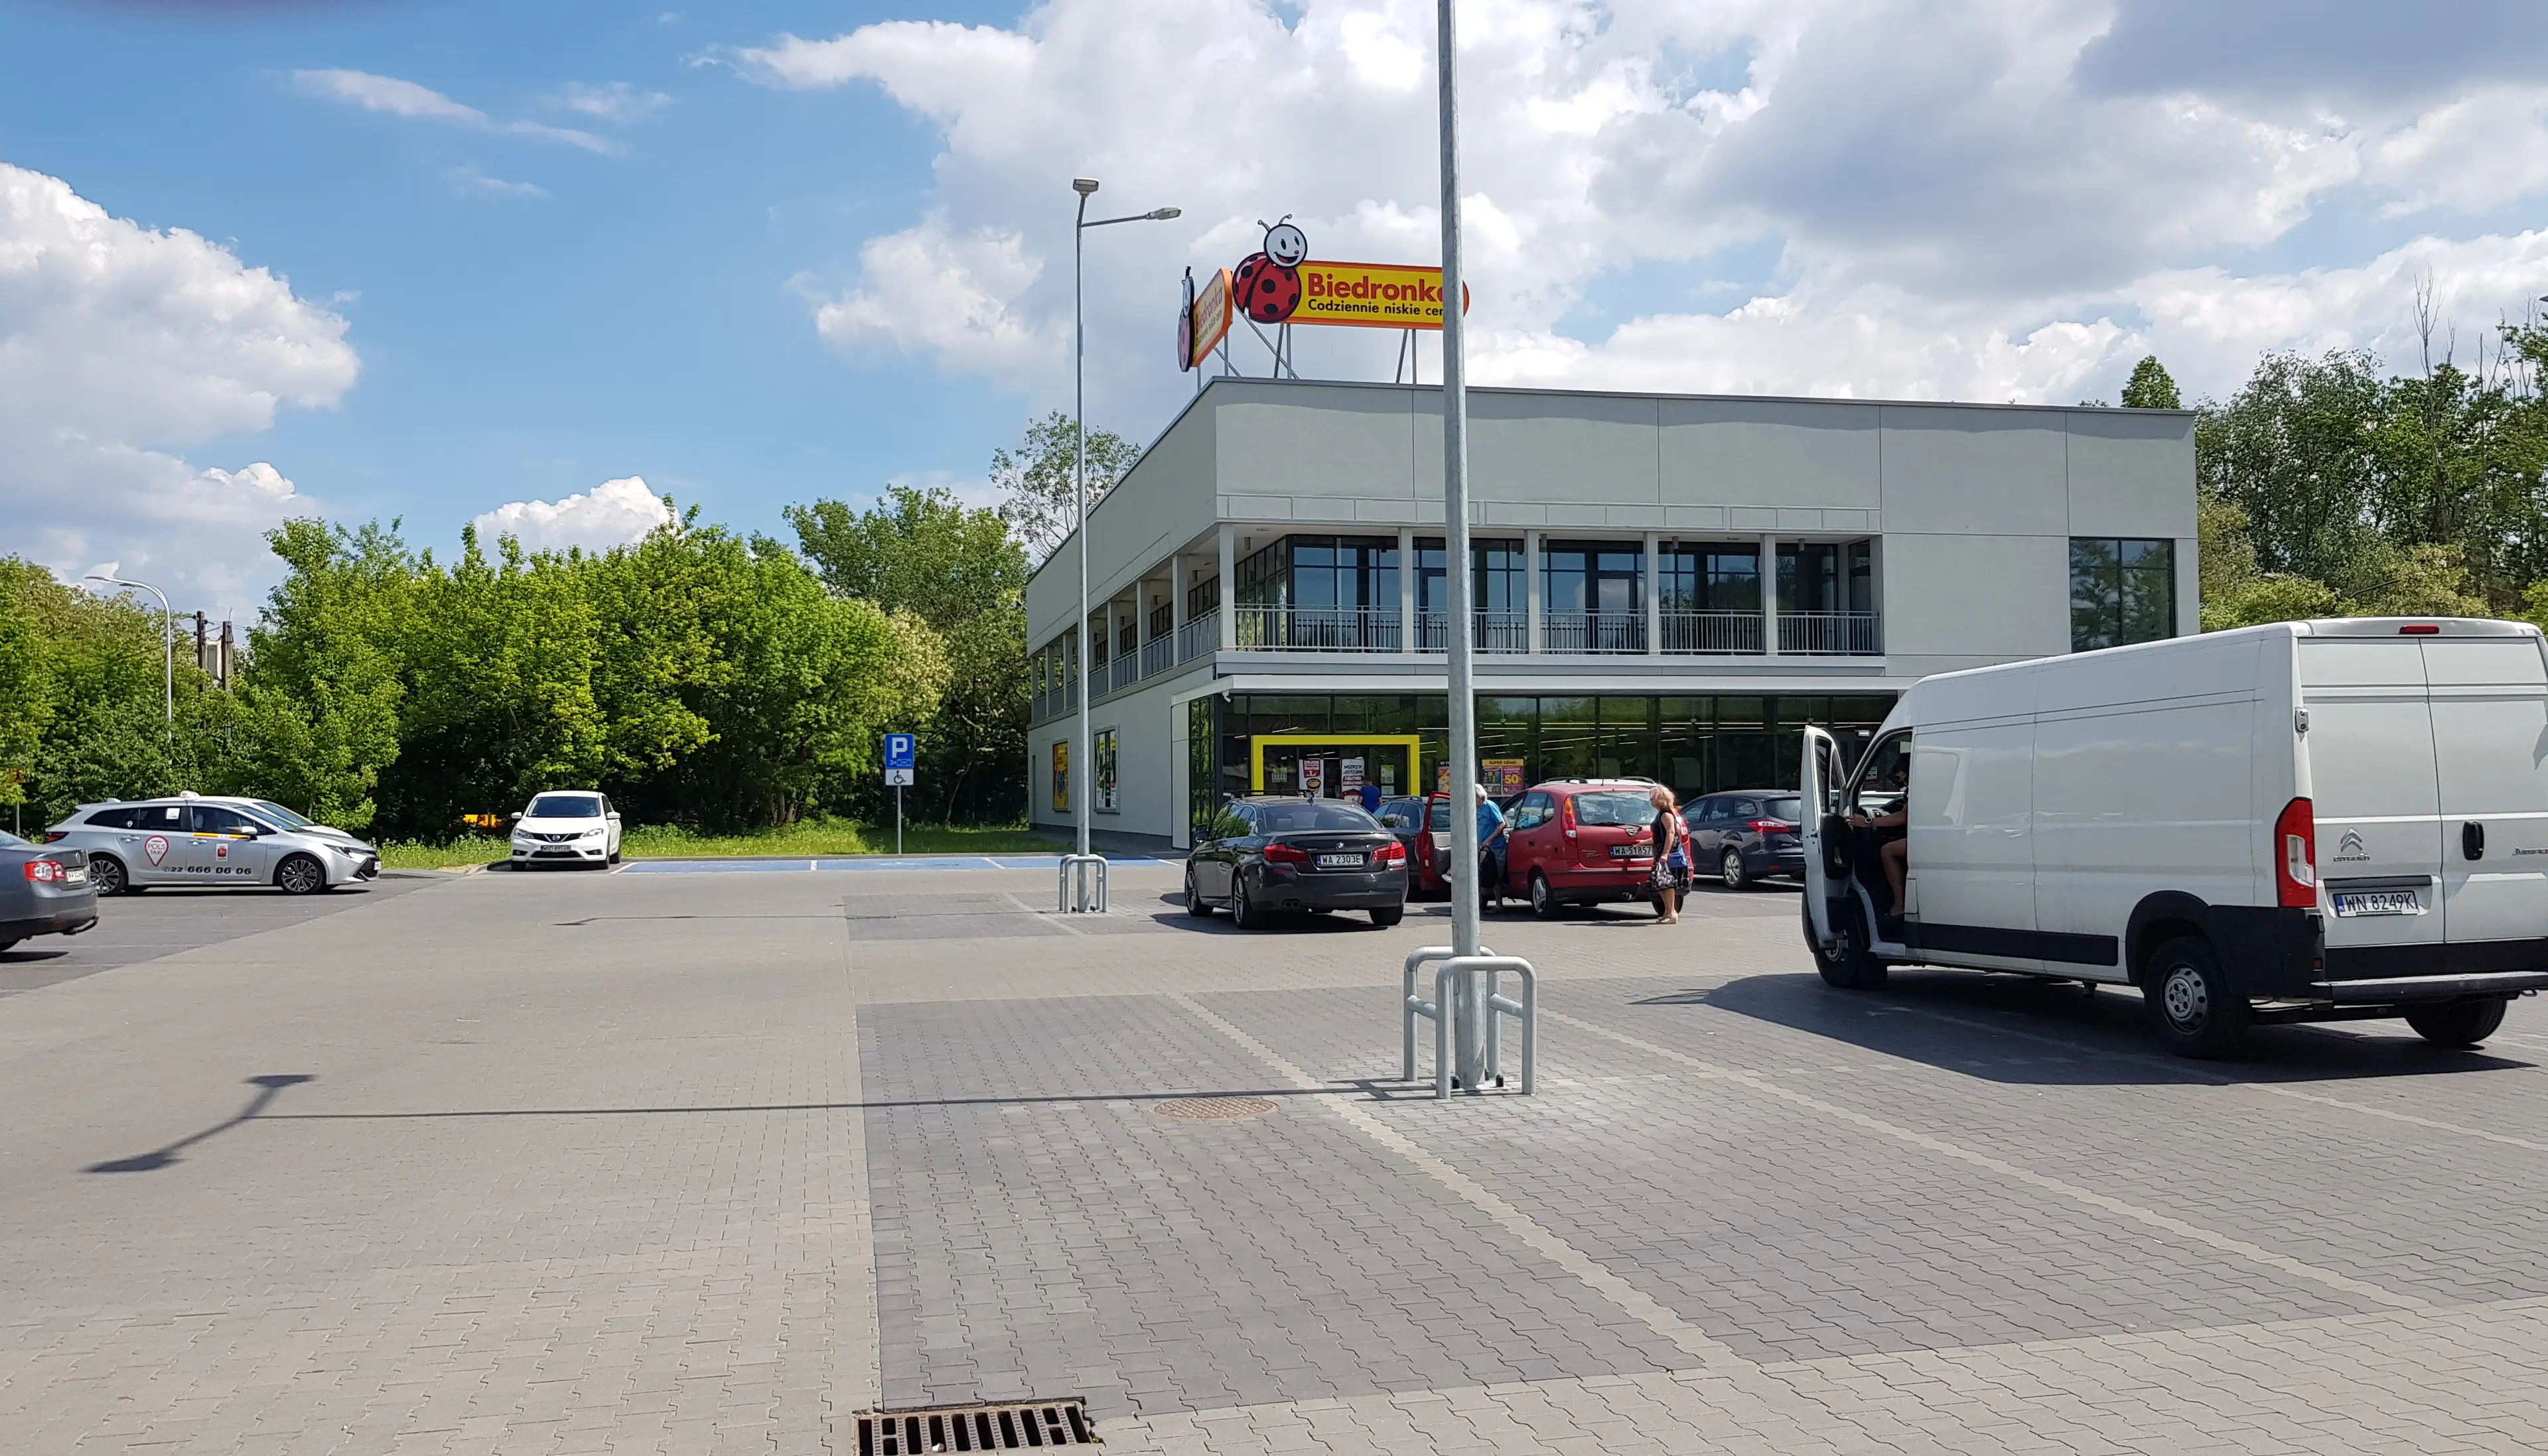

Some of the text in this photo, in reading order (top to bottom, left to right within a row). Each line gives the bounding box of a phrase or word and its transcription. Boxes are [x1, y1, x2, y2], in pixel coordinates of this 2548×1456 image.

[1308, 298, 1380, 313] Codziennie
[1384, 302, 1421, 315] niskie
[892, 737, 908, 758] P
[1628, 846, 1652, 854] 51857
[1322, 854, 1362, 864] WA 2303E
[2344, 893, 2415, 911] WN 8249K
